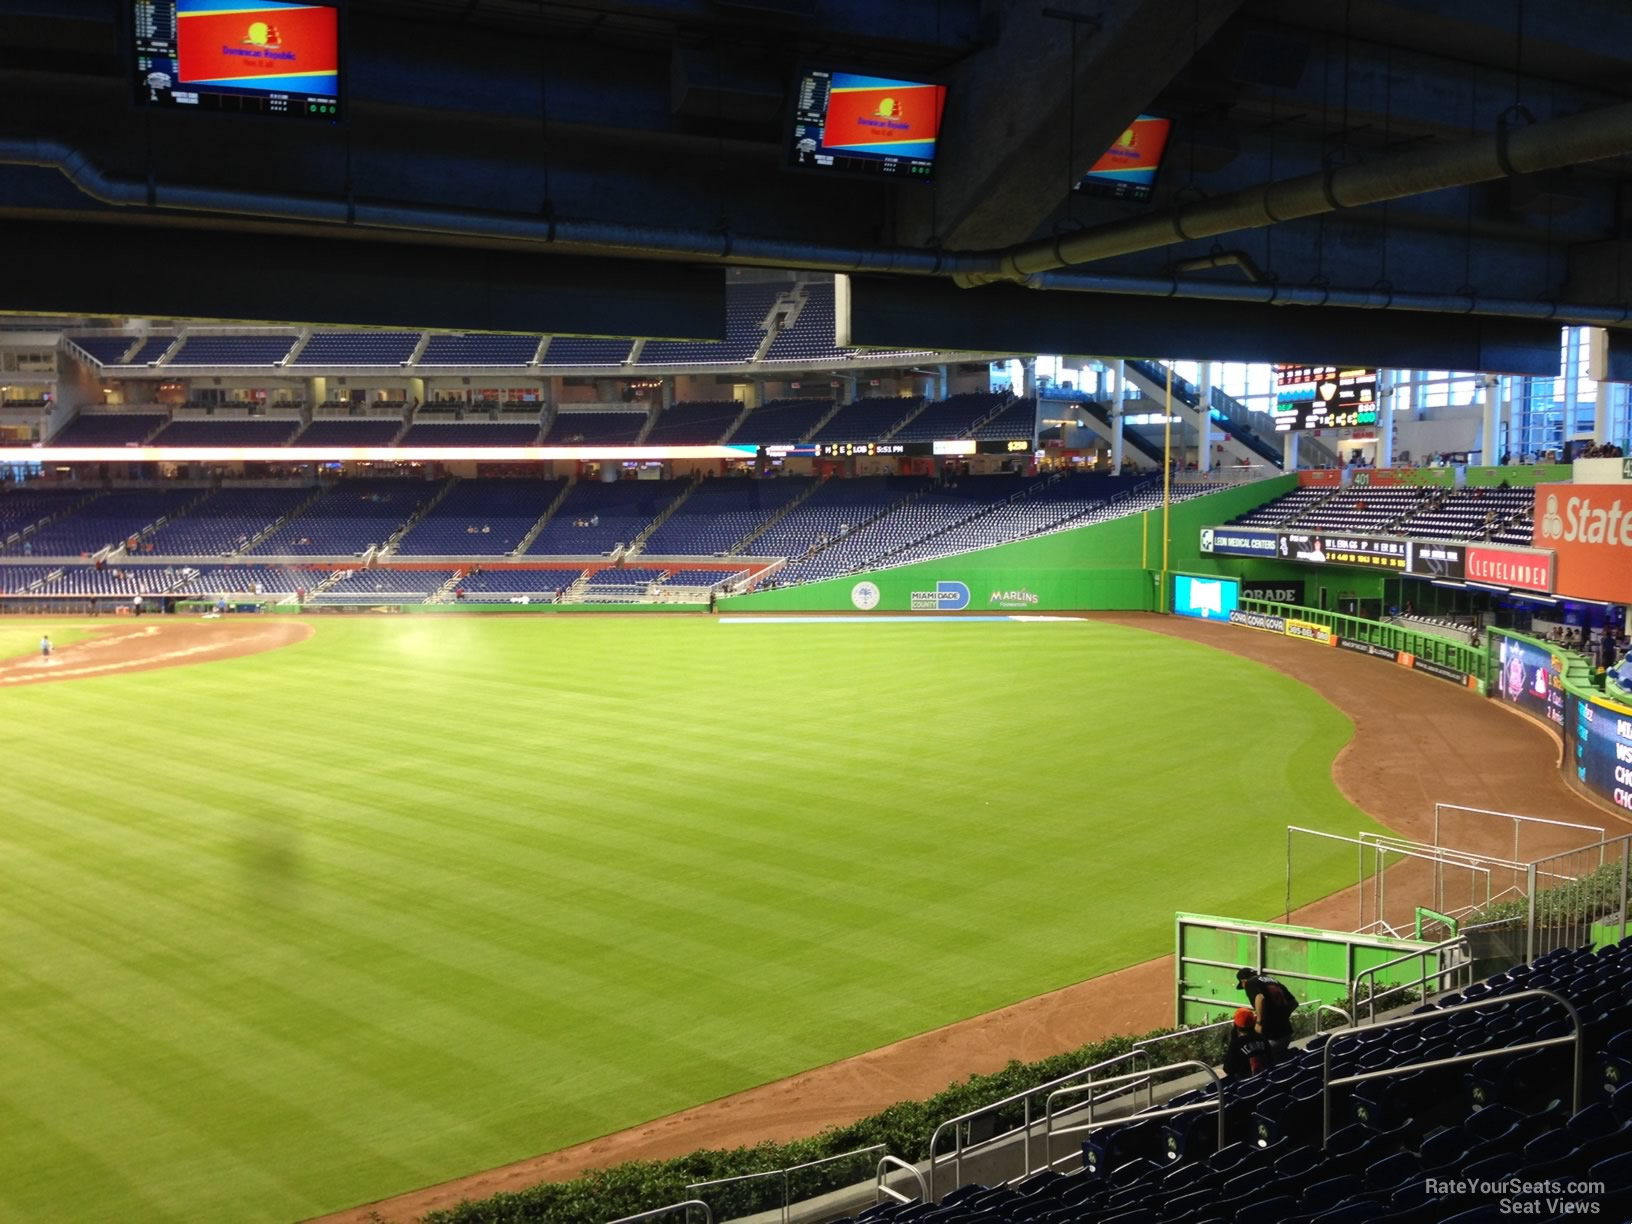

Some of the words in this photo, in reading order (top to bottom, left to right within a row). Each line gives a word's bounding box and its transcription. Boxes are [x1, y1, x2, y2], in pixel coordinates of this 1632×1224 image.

[264, 49, 296, 60] Republic
[893, 445, 904, 453] PM
[1354, 473, 1369, 485] 401
[1564, 497, 1632, 547] State
[1214, 537, 1227, 546] LEON
[1228, 538, 1251, 548] MEDICAL
[1251, 539, 1276, 550] CENTERS
[1469, 551, 1547, 586] CLEVELANDER
[990, 591, 1039, 604] MARLINS
[1230, 611, 1247, 624] GOYA
[1248, 614, 1265, 628] GOYA
[1266, 618, 1284, 631] GOYA
[1617, 719, 1632, 740] MI
